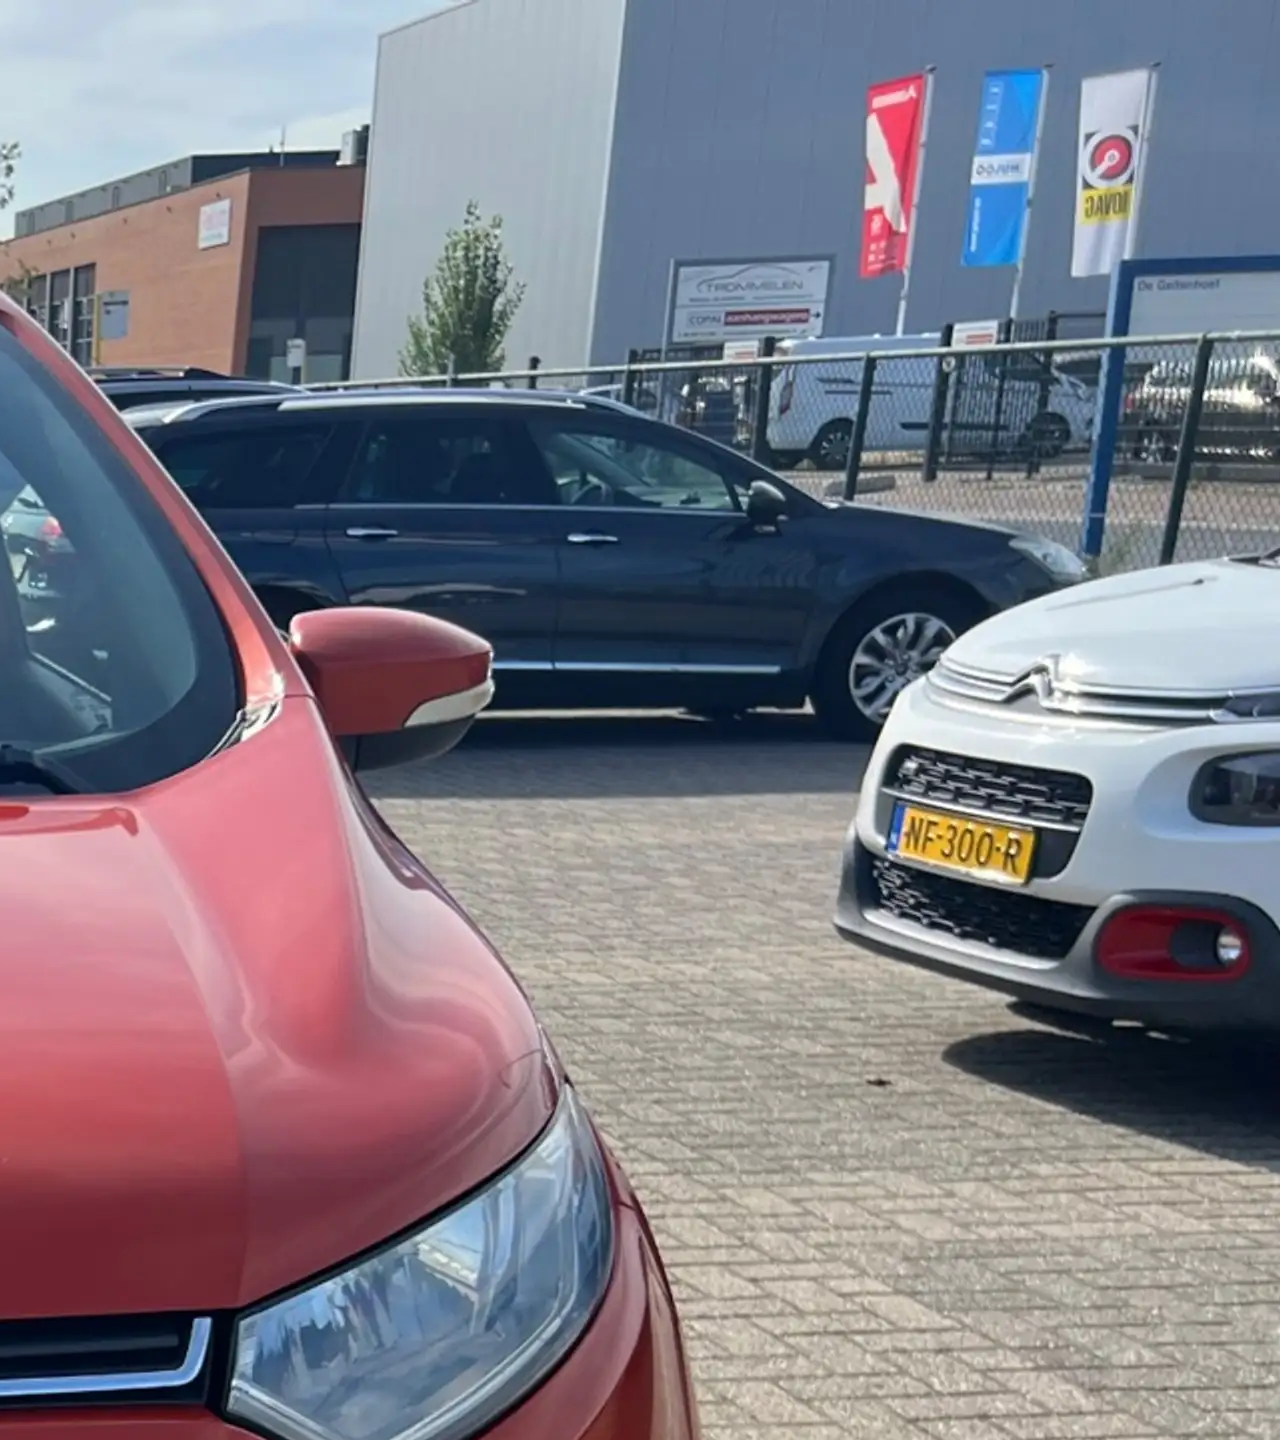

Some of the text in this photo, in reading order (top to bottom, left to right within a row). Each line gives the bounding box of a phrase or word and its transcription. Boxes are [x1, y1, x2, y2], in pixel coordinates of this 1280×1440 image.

[706, 279, 804, 293] TROMMELEN
[1137, 280, 1153, 291] De
[904, 815, 1023, 875] NF-300-R
